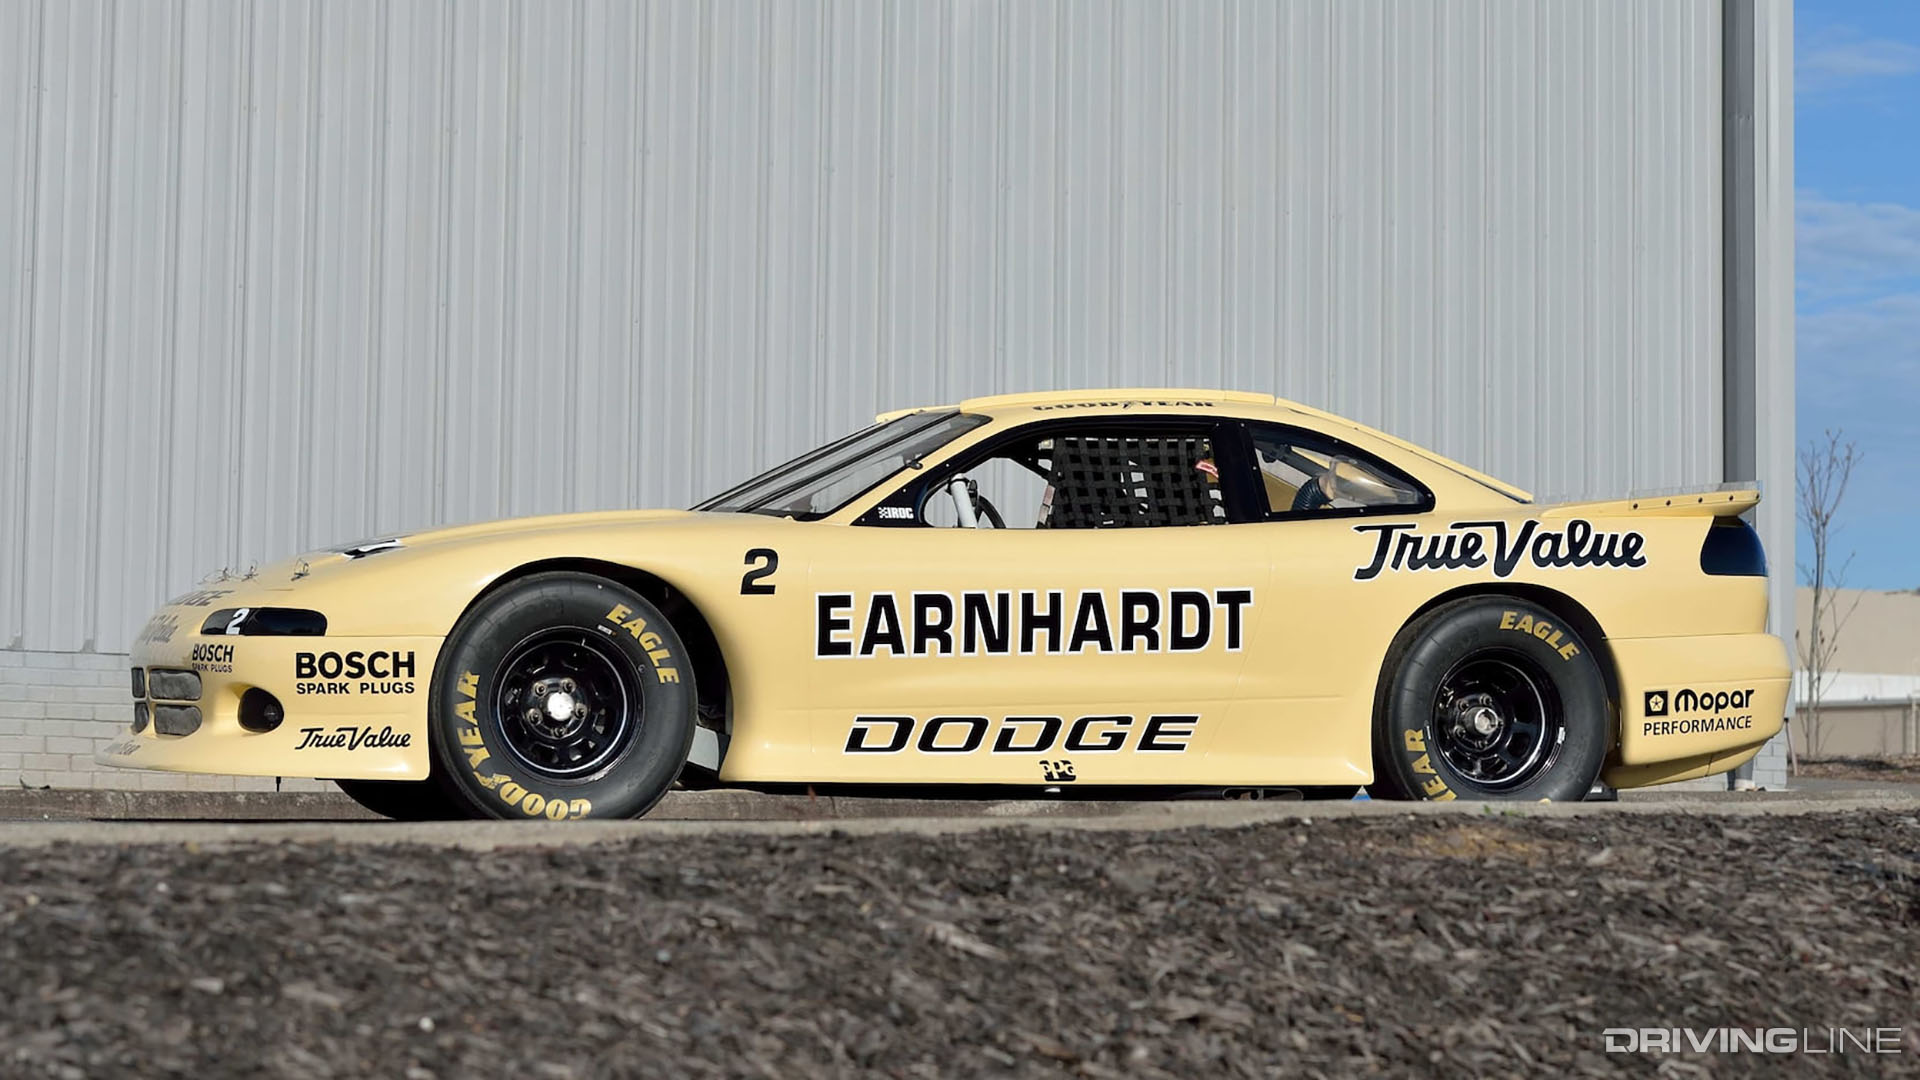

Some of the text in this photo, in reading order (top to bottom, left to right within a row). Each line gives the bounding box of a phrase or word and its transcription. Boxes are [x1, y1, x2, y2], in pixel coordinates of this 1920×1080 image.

[885, 506, 914, 519] IROC
[741, 548, 778, 595] 2
[226, 608, 249, 635] 2
[814, 588, 1254, 659] EARNHARDT
[606, 603, 680, 684] EAGLE
[1499, 611, 1580, 661] EAGLE
[192, 643, 234, 663] BOSCH
[295, 651, 415, 679] BOSCH
[296, 682, 415, 694] SPARK PLUGS
[1674, 688, 1755, 714] Mopar
[454, 670, 492, 769] YEAR
[1643, 715, 1752, 736] PERFORMANCE
[843, 714, 1200, 755] DODGE
